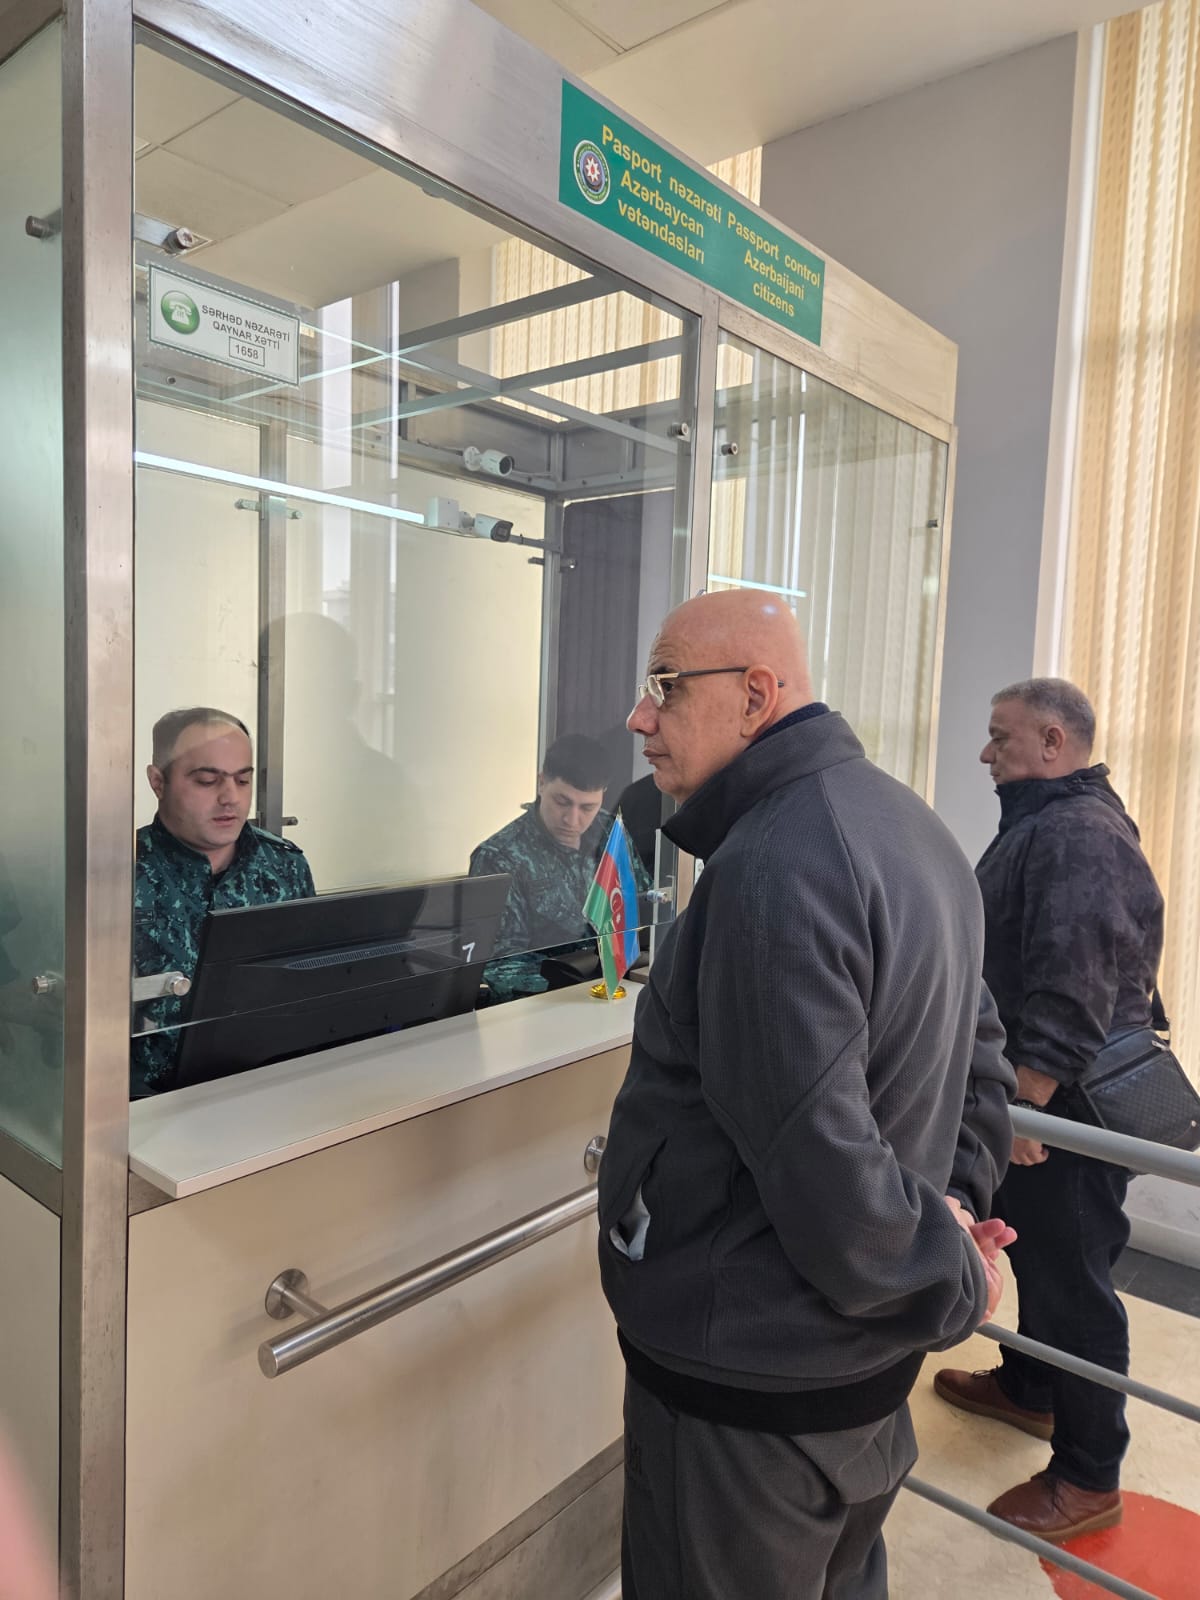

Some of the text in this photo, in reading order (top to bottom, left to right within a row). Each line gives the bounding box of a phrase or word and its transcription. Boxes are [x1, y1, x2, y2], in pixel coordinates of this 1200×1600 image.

[602, 125, 662, 183] Pasport
[669, 176, 722, 223] nəzarəti
[620, 170, 704, 238] Azərbaycan
[727, 211, 820, 288] Passport control
[744, 249, 805, 300] Azerbaijani
[201, 305, 243, 326] SƏRHƏD
[753, 283, 794, 317] citizens
[212, 320, 252, 341] QAYNAR
[235, 344, 259, 360] 1658
